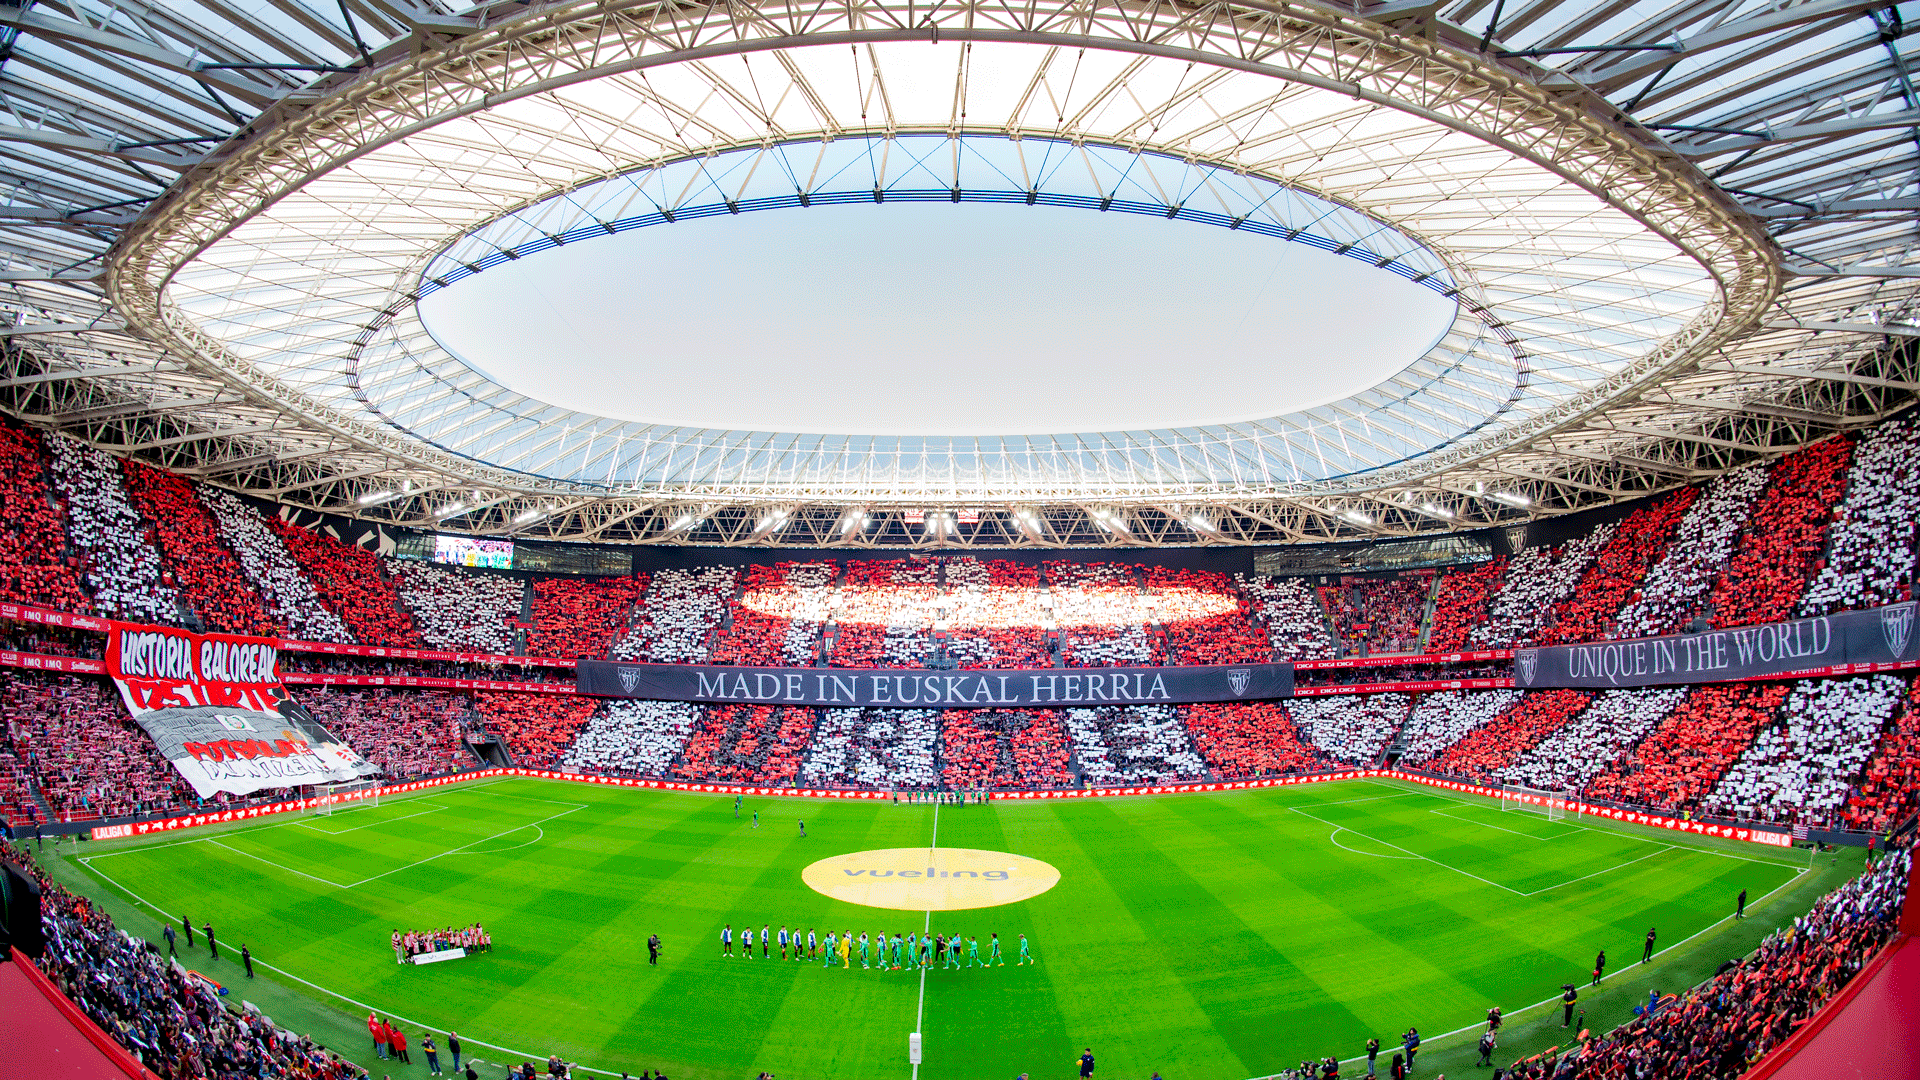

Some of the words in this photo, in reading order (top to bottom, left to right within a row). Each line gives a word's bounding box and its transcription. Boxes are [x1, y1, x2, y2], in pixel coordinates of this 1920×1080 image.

[24, 610, 42, 622] IMQ
[45, 613, 63, 626] IMQ
[120, 629, 200, 686] HISTORIA,
[1568, 642, 1648, 686] UNIQUE
[1652, 639, 1677, 674] IN
[1681, 632, 1729, 672] THE
[1732, 616, 1831, 666] WORLD
[23, 657, 42, 669] IMQ
[45, 659, 63, 671] IMQ
[695, 671, 805, 701] MADE
[815, 674, 859, 703] IN
[869, 675, 1019, 704] EUSKAL
[1030, 672, 1172, 703] HERRIA
[95, 825, 123, 839] LALIGA
[1752, 831, 1780, 845] LALIGA
[843, 867, 1010, 881] vueling
